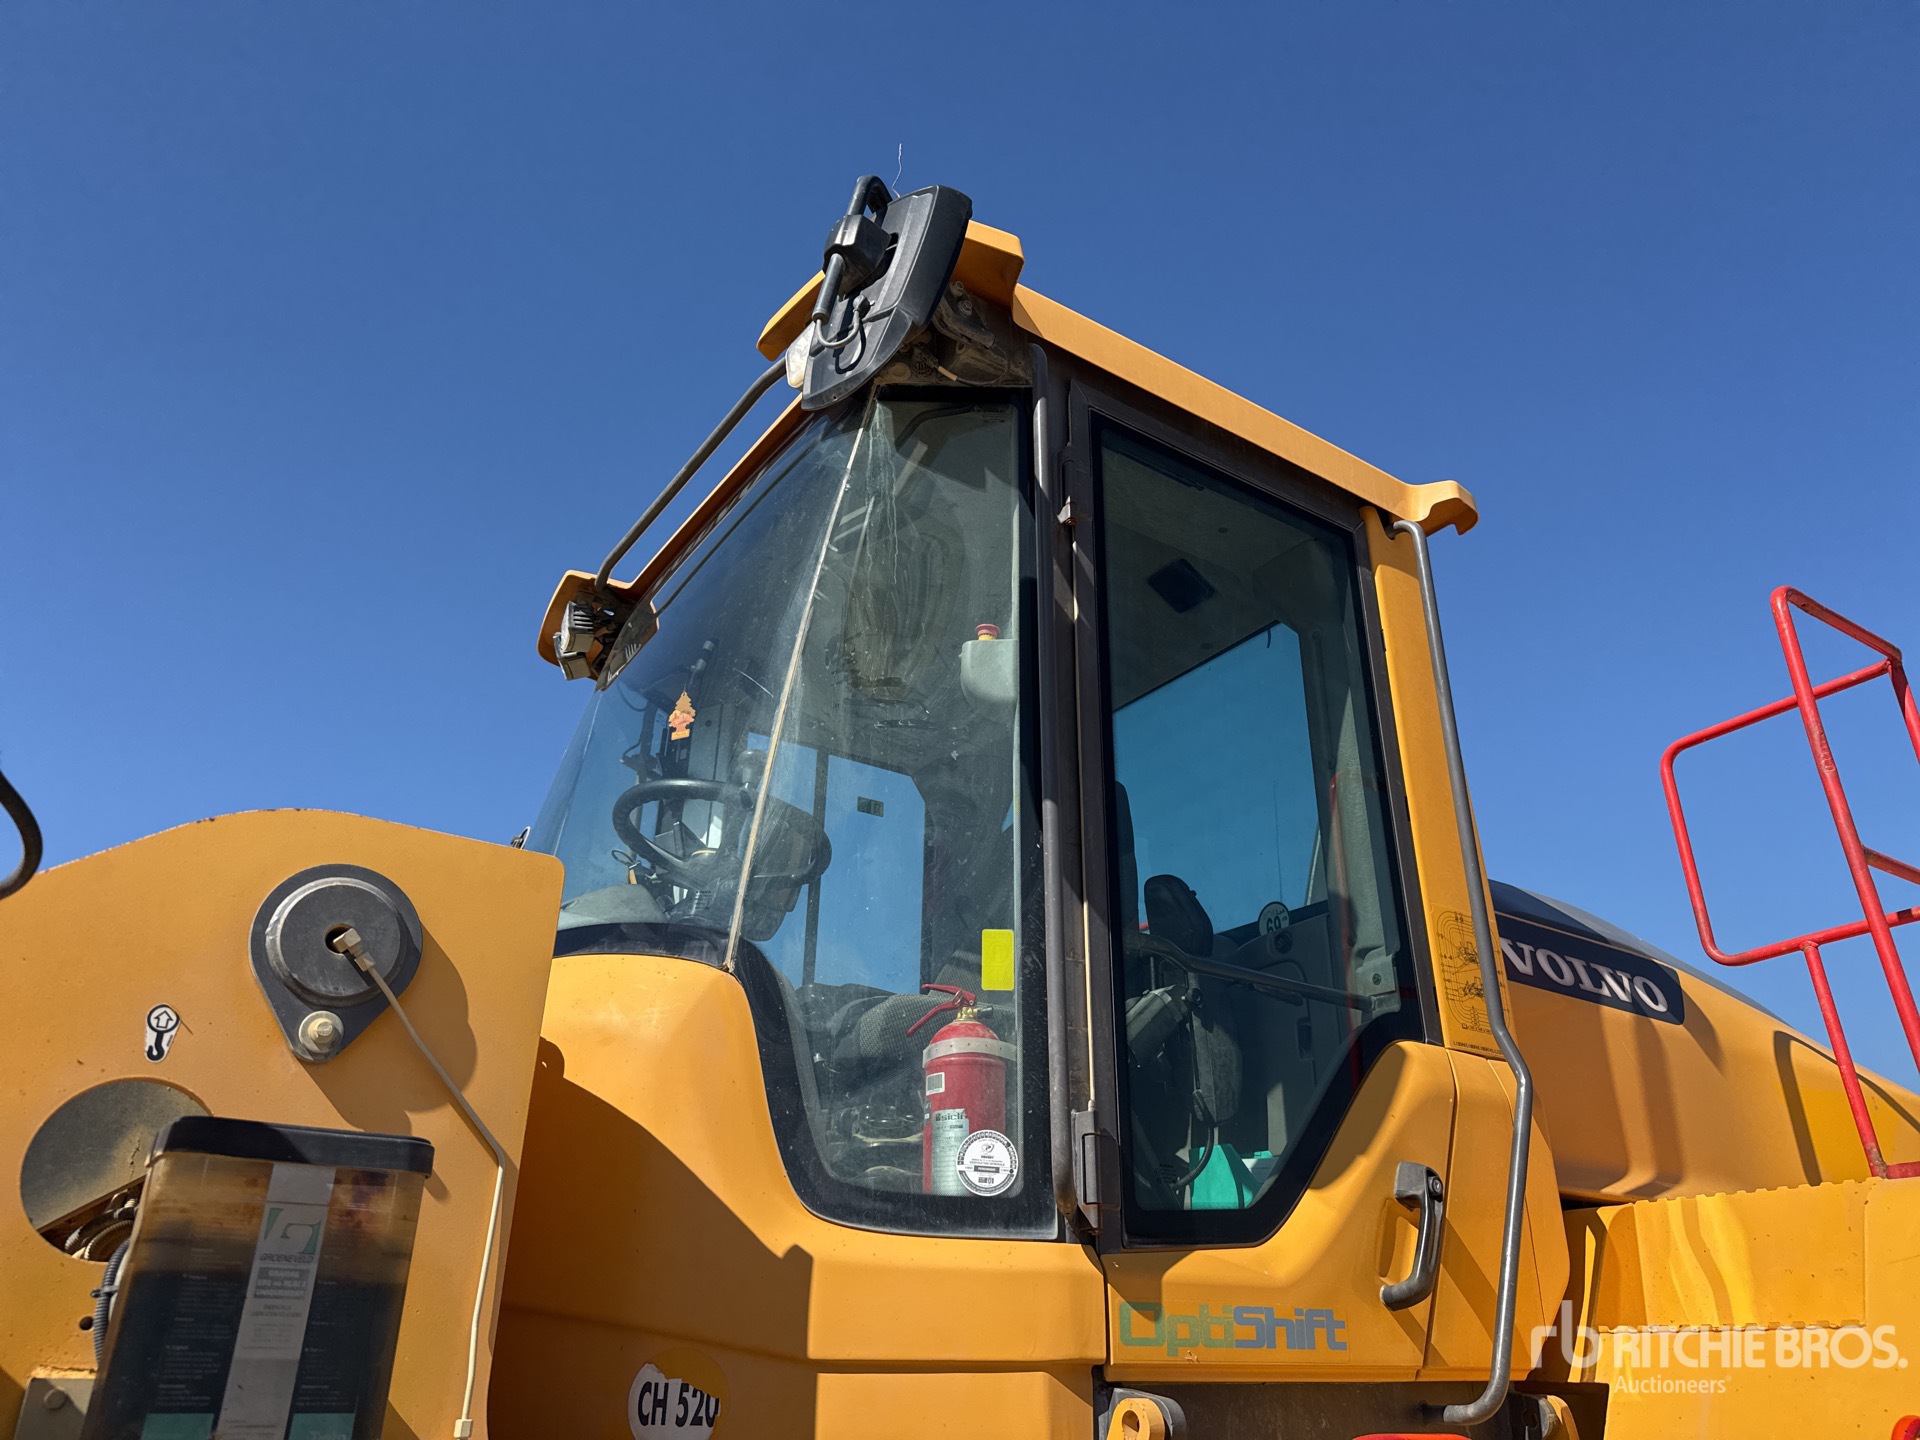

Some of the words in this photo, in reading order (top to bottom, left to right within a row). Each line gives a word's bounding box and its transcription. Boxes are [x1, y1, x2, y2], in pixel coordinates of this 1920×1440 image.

[1499, 937, 1668, 1013] VOLVO
[1119, 1302, 1348, 1357] OptiShift
[637, 1381, 670, 1427] CH
